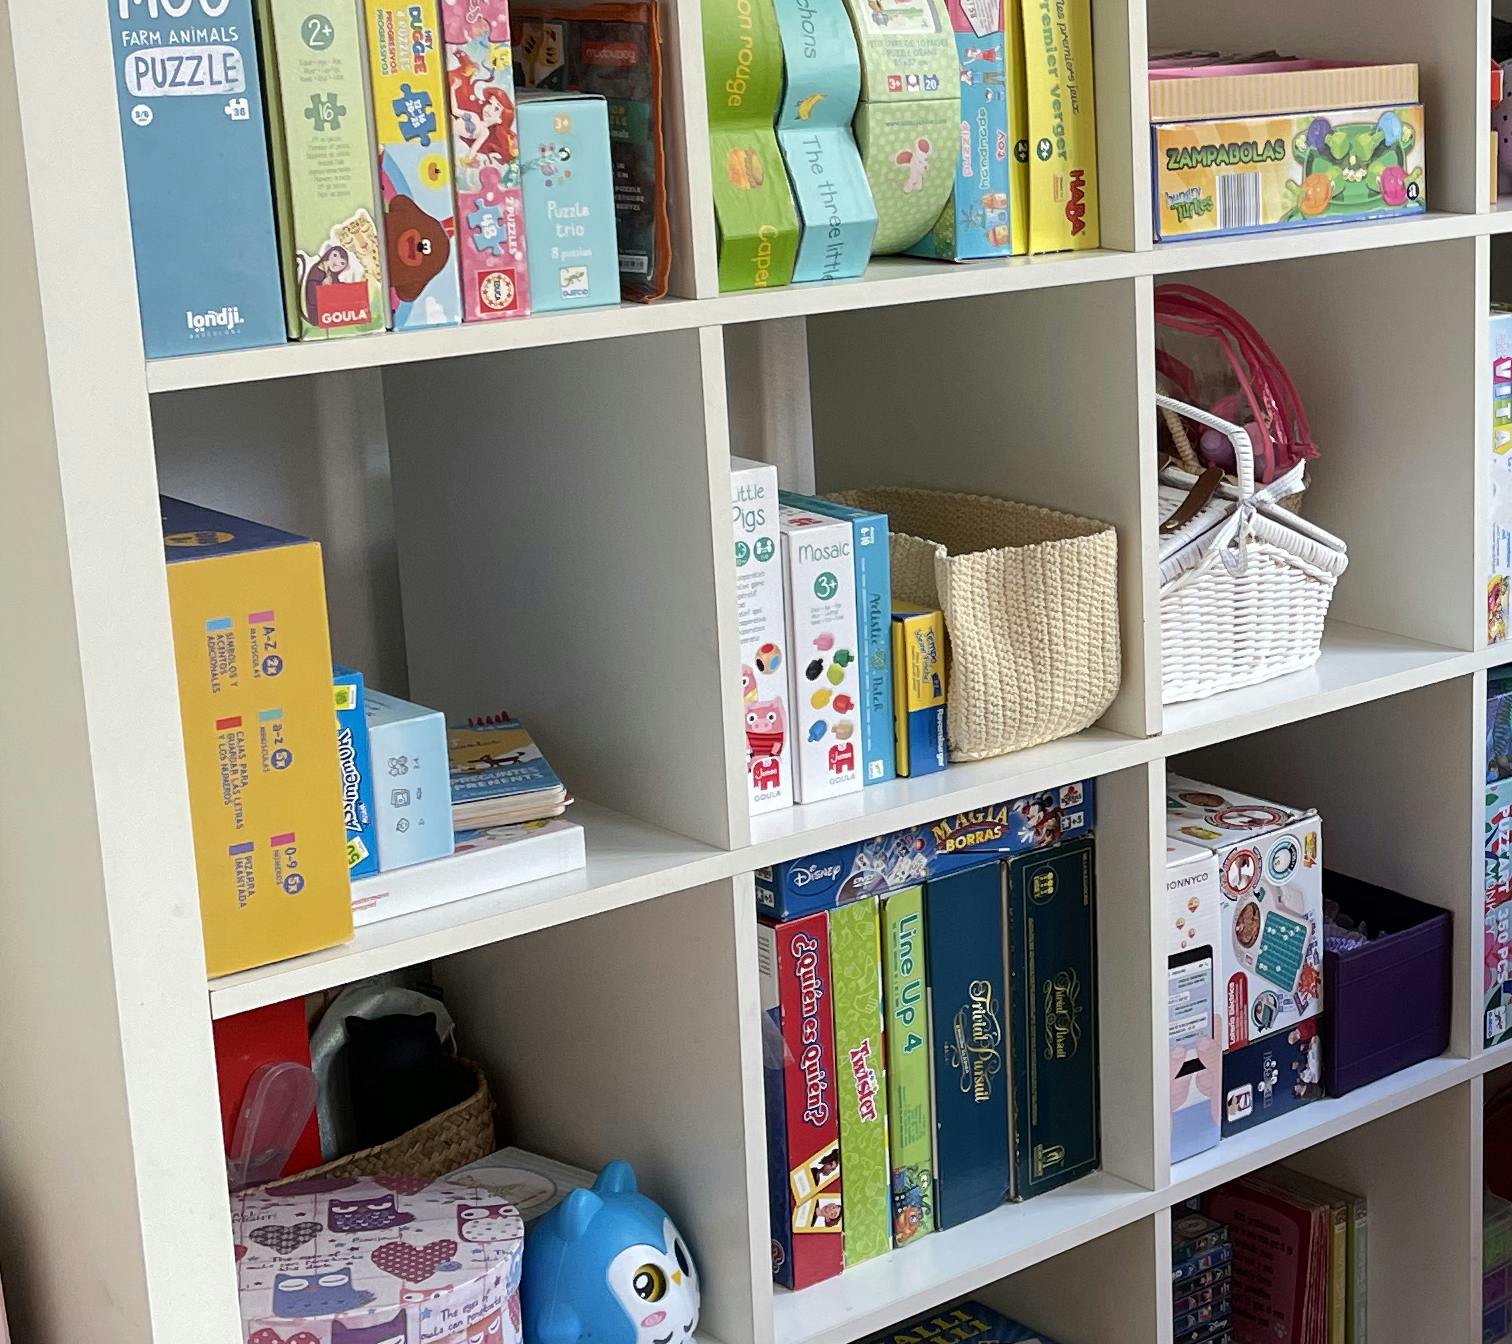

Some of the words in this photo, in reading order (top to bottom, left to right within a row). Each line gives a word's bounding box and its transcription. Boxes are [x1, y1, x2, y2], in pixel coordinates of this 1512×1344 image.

[122, 30, 161, 47] FARM
[169, 25, 239, 44] ANIMALS
[307, 18, 333, 47] 2+
[408, 5, 428, 76] DUGGEE
[423, 28, 434, 52] HEY
[134, 52, 239, 91] PUZZLE
[725, 36, 753, 107] rouge
[1057, 22, 1076, 82] premiers
[1067, 84, 1080, 114] jeux
[318, 103, 335, 121] 16
[1166, 138, 1286, 171] ZAMPABOLAS
[802, 135, 824, 176] The
[818, 179, 841, 239] three
[1065, 169, 1086, 237] HABA
[547, 201, 590, 219] Puzzle
[506, 206, 518, 255] PUZZLES
[555, 222, 585, 238] trio
[321, 309, 368, 325] GOULA
[1493, 358, 1512, 451] VITA
[799, 541, 850, 564] Mosaic
[815, 575, 838, 598] 3+
[935, 708, 945, 767] Ravensburger
[931, 806, 1008, 845] MAGIA
[946, 826, 1002, 852] BORRAS
[245, 855, 256, 897] PIZARRA
[794, 860, 841, 888] Disney
[898, 912, 921, 977] Line
[894, 978, 922, 1026] Up
[801, 1017, 819, 1043] es
[902, 1032, 924, 1055] 4
[848, 1037, 880, 1122] Twister
